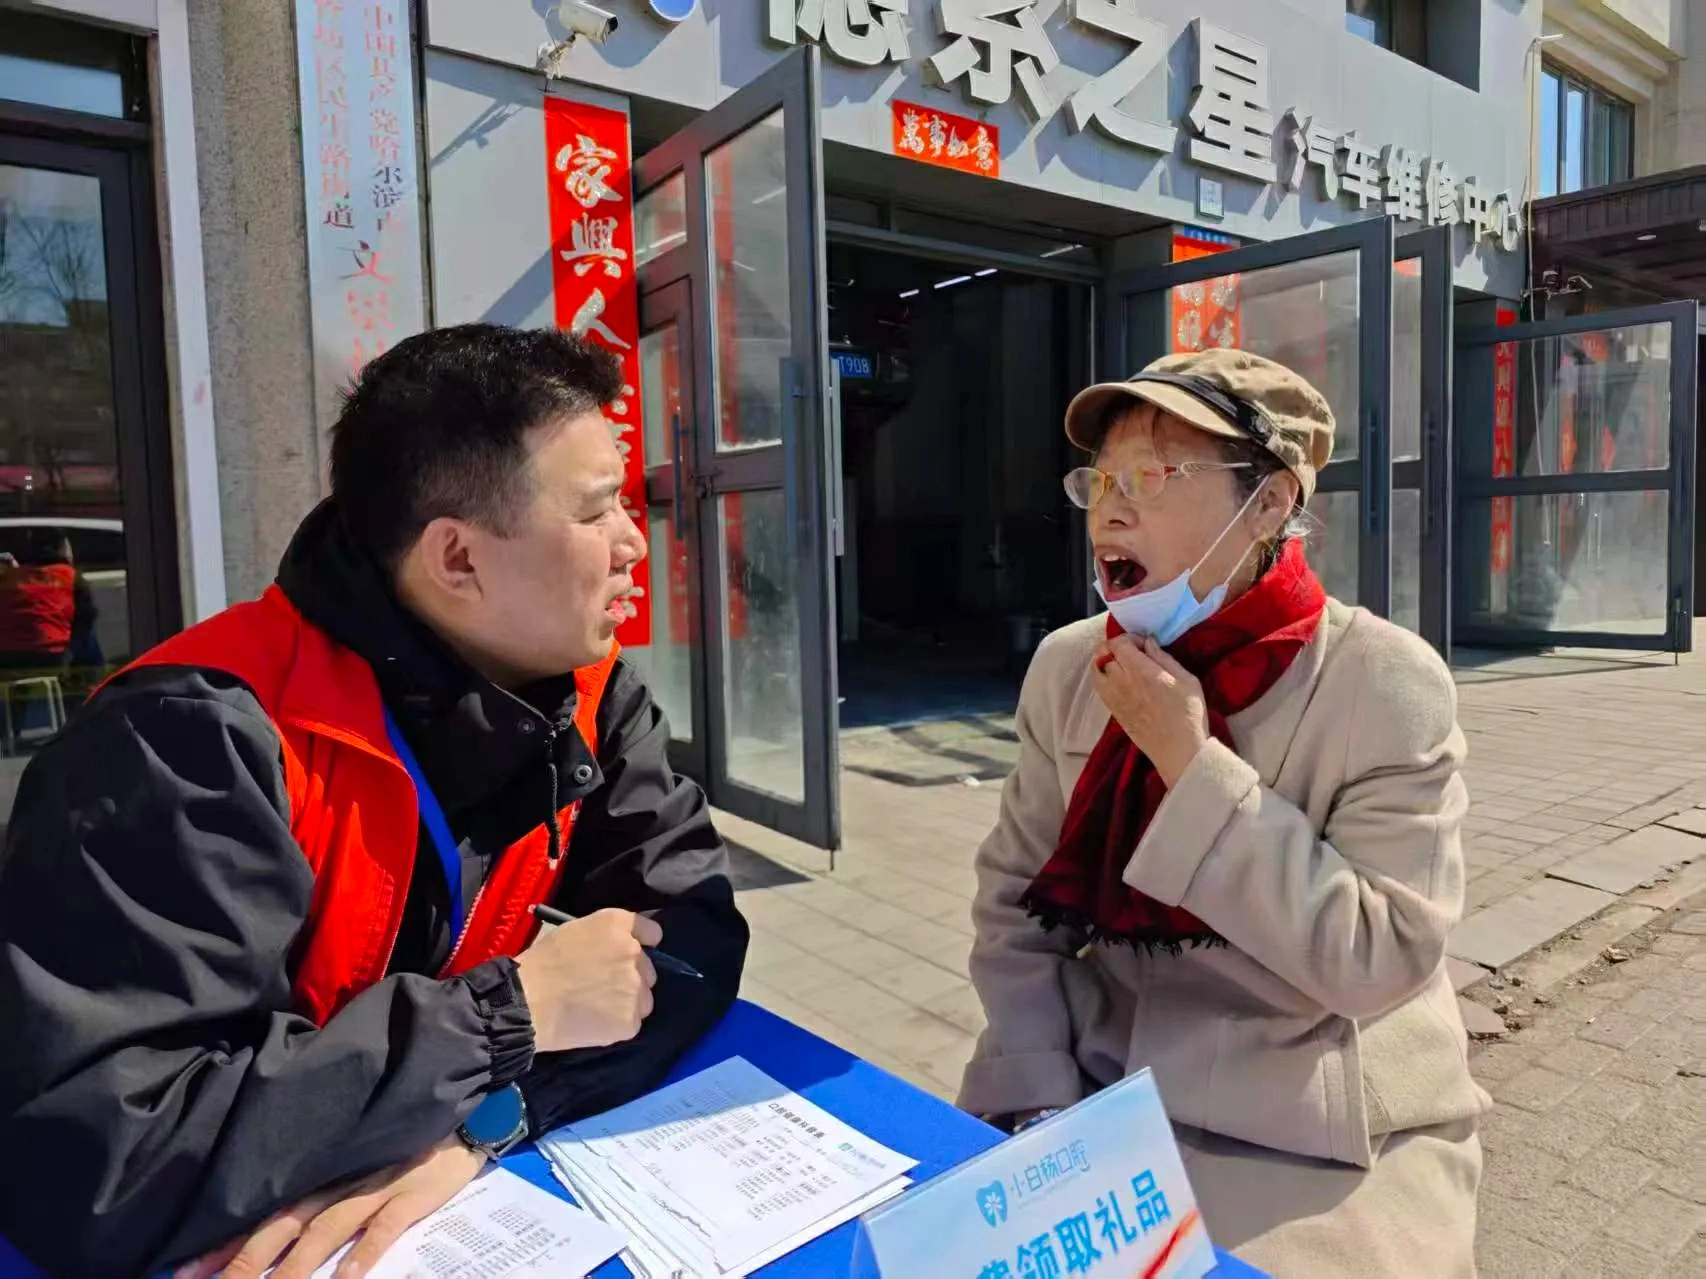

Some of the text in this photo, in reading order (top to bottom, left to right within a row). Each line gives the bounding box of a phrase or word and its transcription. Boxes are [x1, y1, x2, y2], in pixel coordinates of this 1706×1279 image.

[898, 107, 995, 170] 萬事如意
[1276, 107, 1525, 251] 汽车维修中心
[1010, 1139, 1091, 1198] 小白杨口腔
